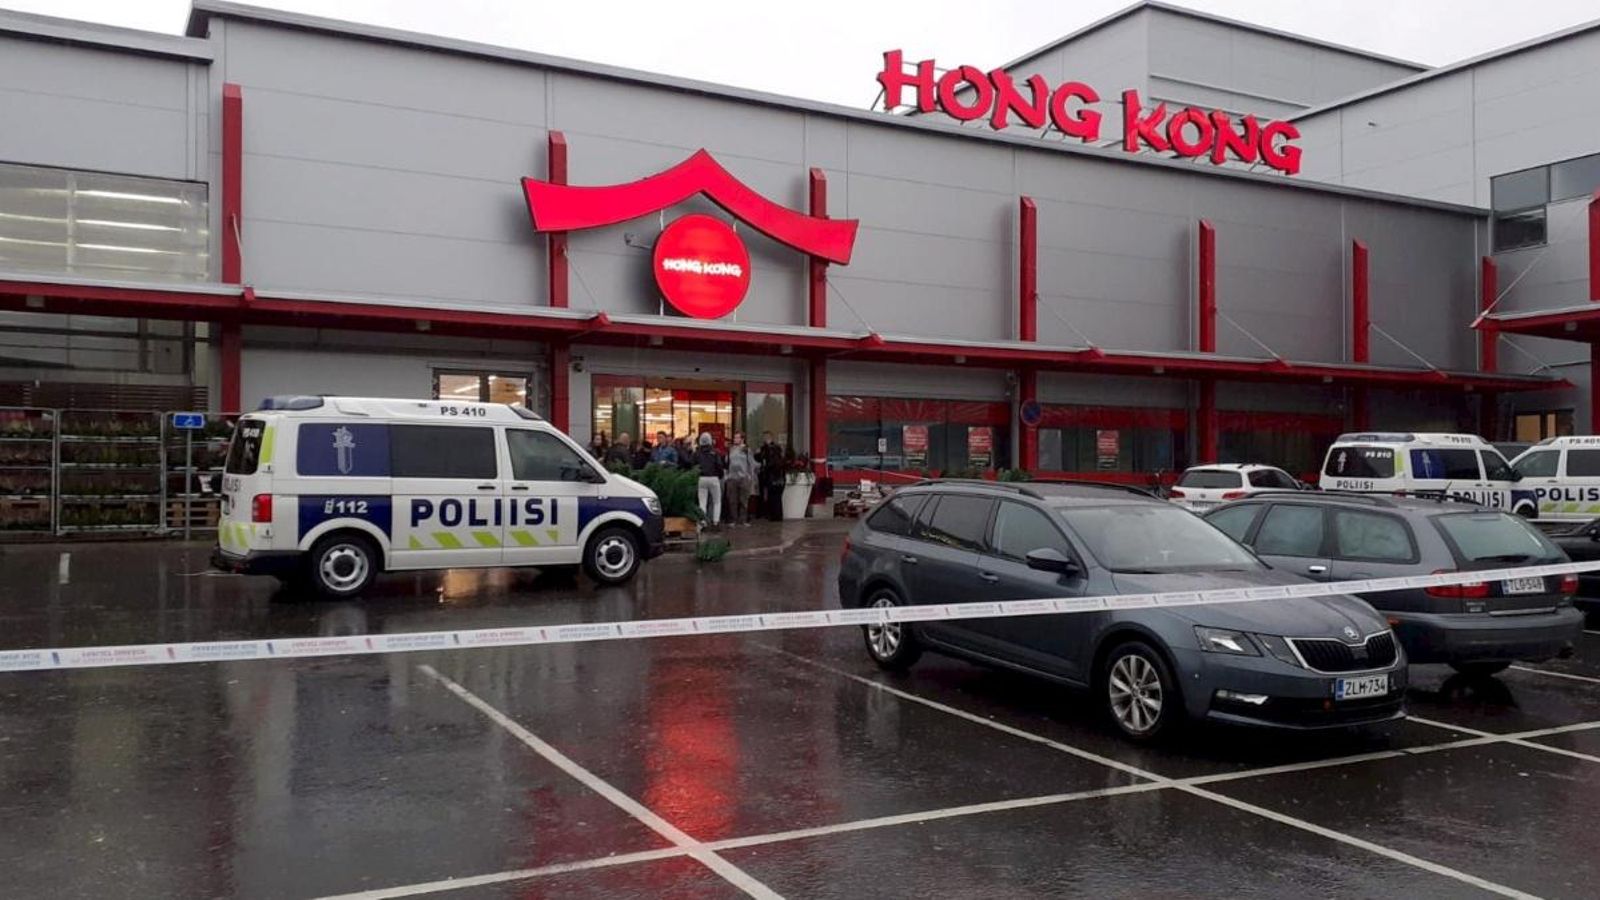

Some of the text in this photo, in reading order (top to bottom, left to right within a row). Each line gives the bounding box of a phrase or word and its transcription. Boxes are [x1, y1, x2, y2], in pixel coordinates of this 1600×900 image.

[877, 49, 1303, 175] HONG KONG
[662, 258, 742, 277] HONG KONG
[440, 406, 486, 417] PS 410
[1336, 480, 1374, 490] POLIISI
[336, 500, 368, 514] 112
[410, 498, 558, 527] POLIISI
[1345, 678, 1386, 697] ZLM-734
